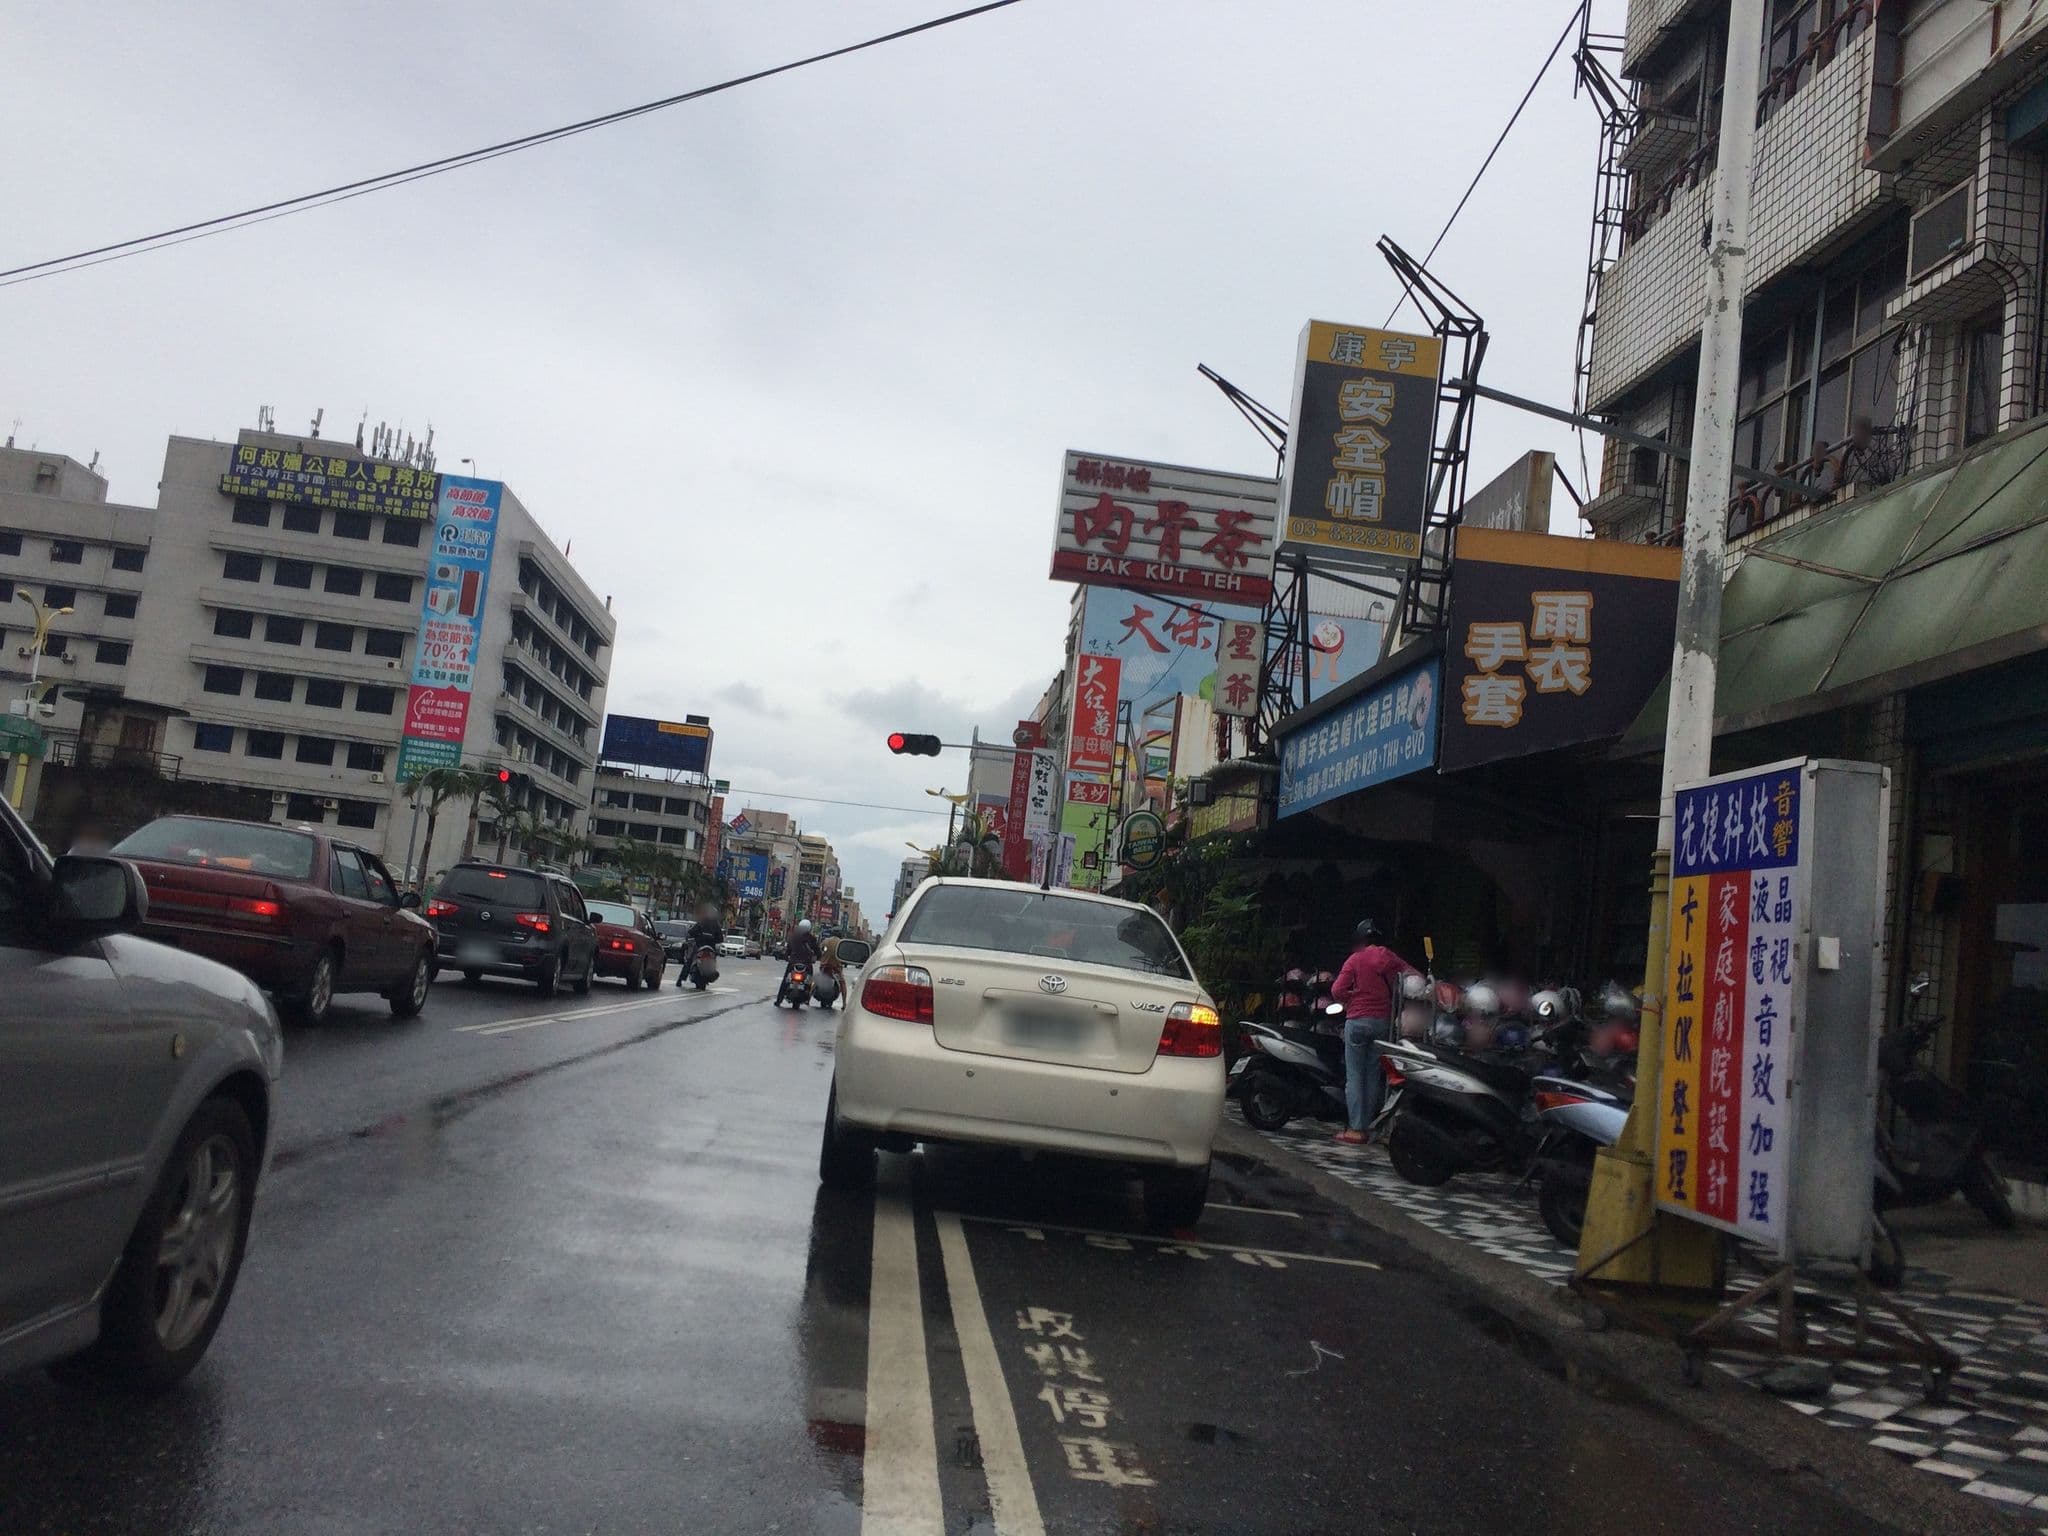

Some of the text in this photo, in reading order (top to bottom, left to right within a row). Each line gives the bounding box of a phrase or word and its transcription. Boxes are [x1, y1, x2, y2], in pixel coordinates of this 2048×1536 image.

[1329, 331, 1417, 370] 康宇
[1327, 378, 1394, 521] 安全帽
[355, 480, 434, 500] 8311899
[446, 487, 488, 504] 高節能
[452, 505, 493, 521] 高效能
[1074, 492, 1263, 569] 肉骨茶
[1086, 555, 1241, 591] BAK KUT TEH
[424, 641, 456, 660] 70%
[1223, 623, 1257, 711] 星爺
[1461, 622, 1528, 728] 手套
[1526, 591, 1594, 696] 雨衣
[1679, 781, 1769, 869] 先捷科技
[1771, 780, 1796, 858] 音響
[1706, 880, 1740, 1211] 家庭劇院設計
